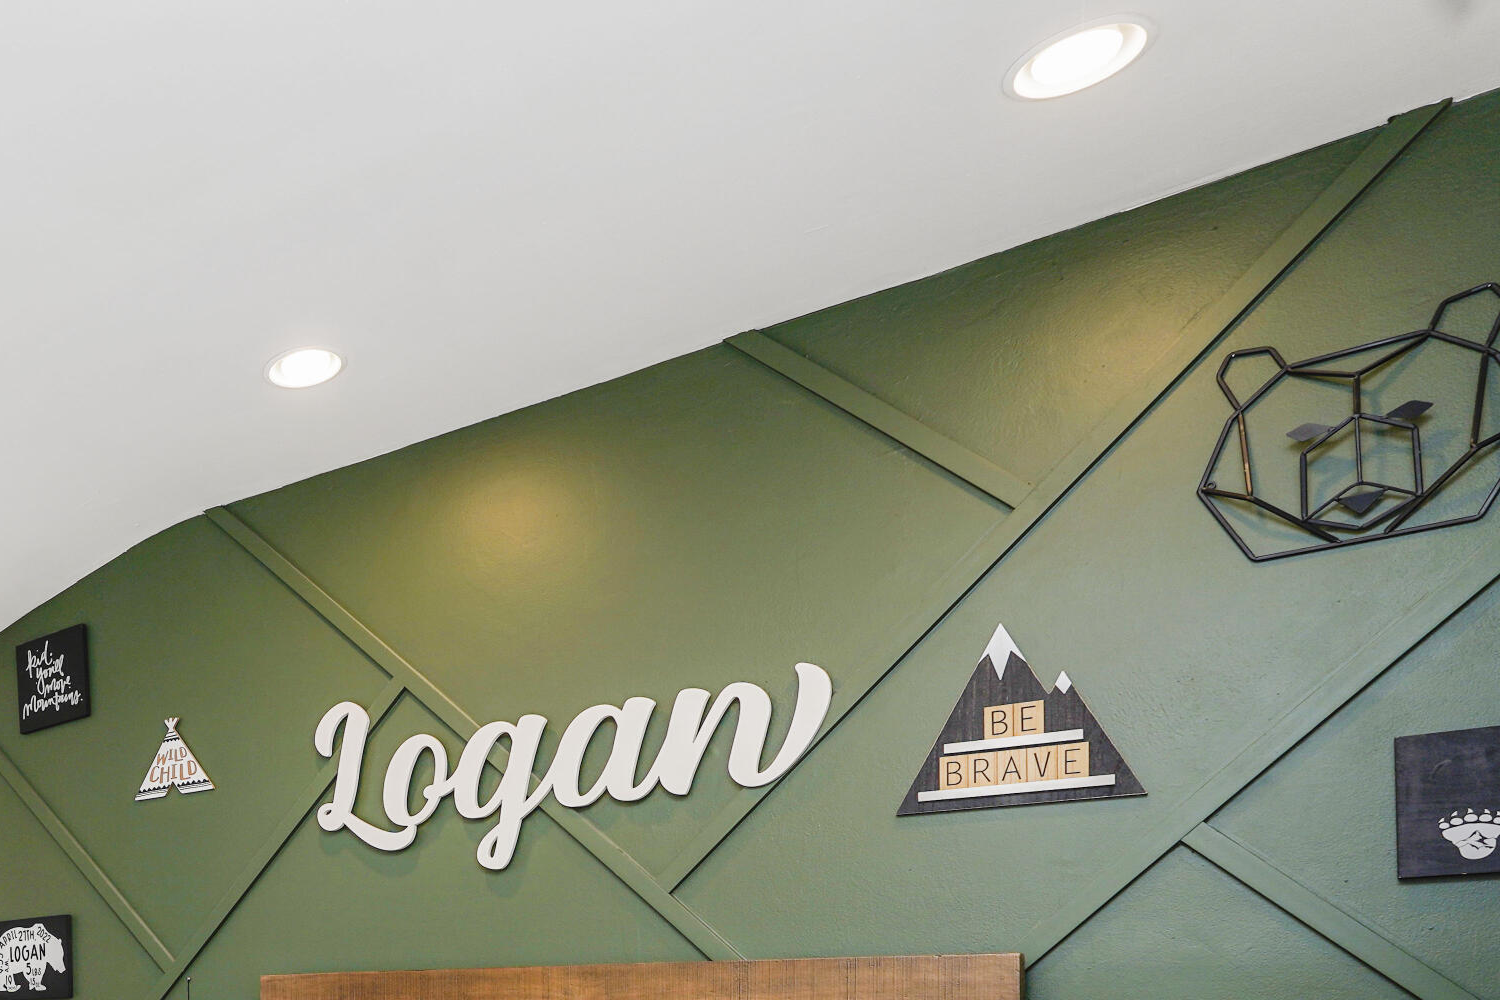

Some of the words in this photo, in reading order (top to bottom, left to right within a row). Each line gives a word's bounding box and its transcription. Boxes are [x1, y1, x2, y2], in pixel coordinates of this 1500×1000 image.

[991, 705, 1036, 736] BE
[156, 746, 188, 766] WILD
[314, 661, 832, 870] Logan
[946, 748, 1081, 786] BRAVE
[149, 760, 198, 785] CHILD
[0, 930, 18, 949] APRIL
[36, 926, 52, 943] 2022
[9, 943, 46, 962] LOGAN
[26, 962, 32, 976] 5
